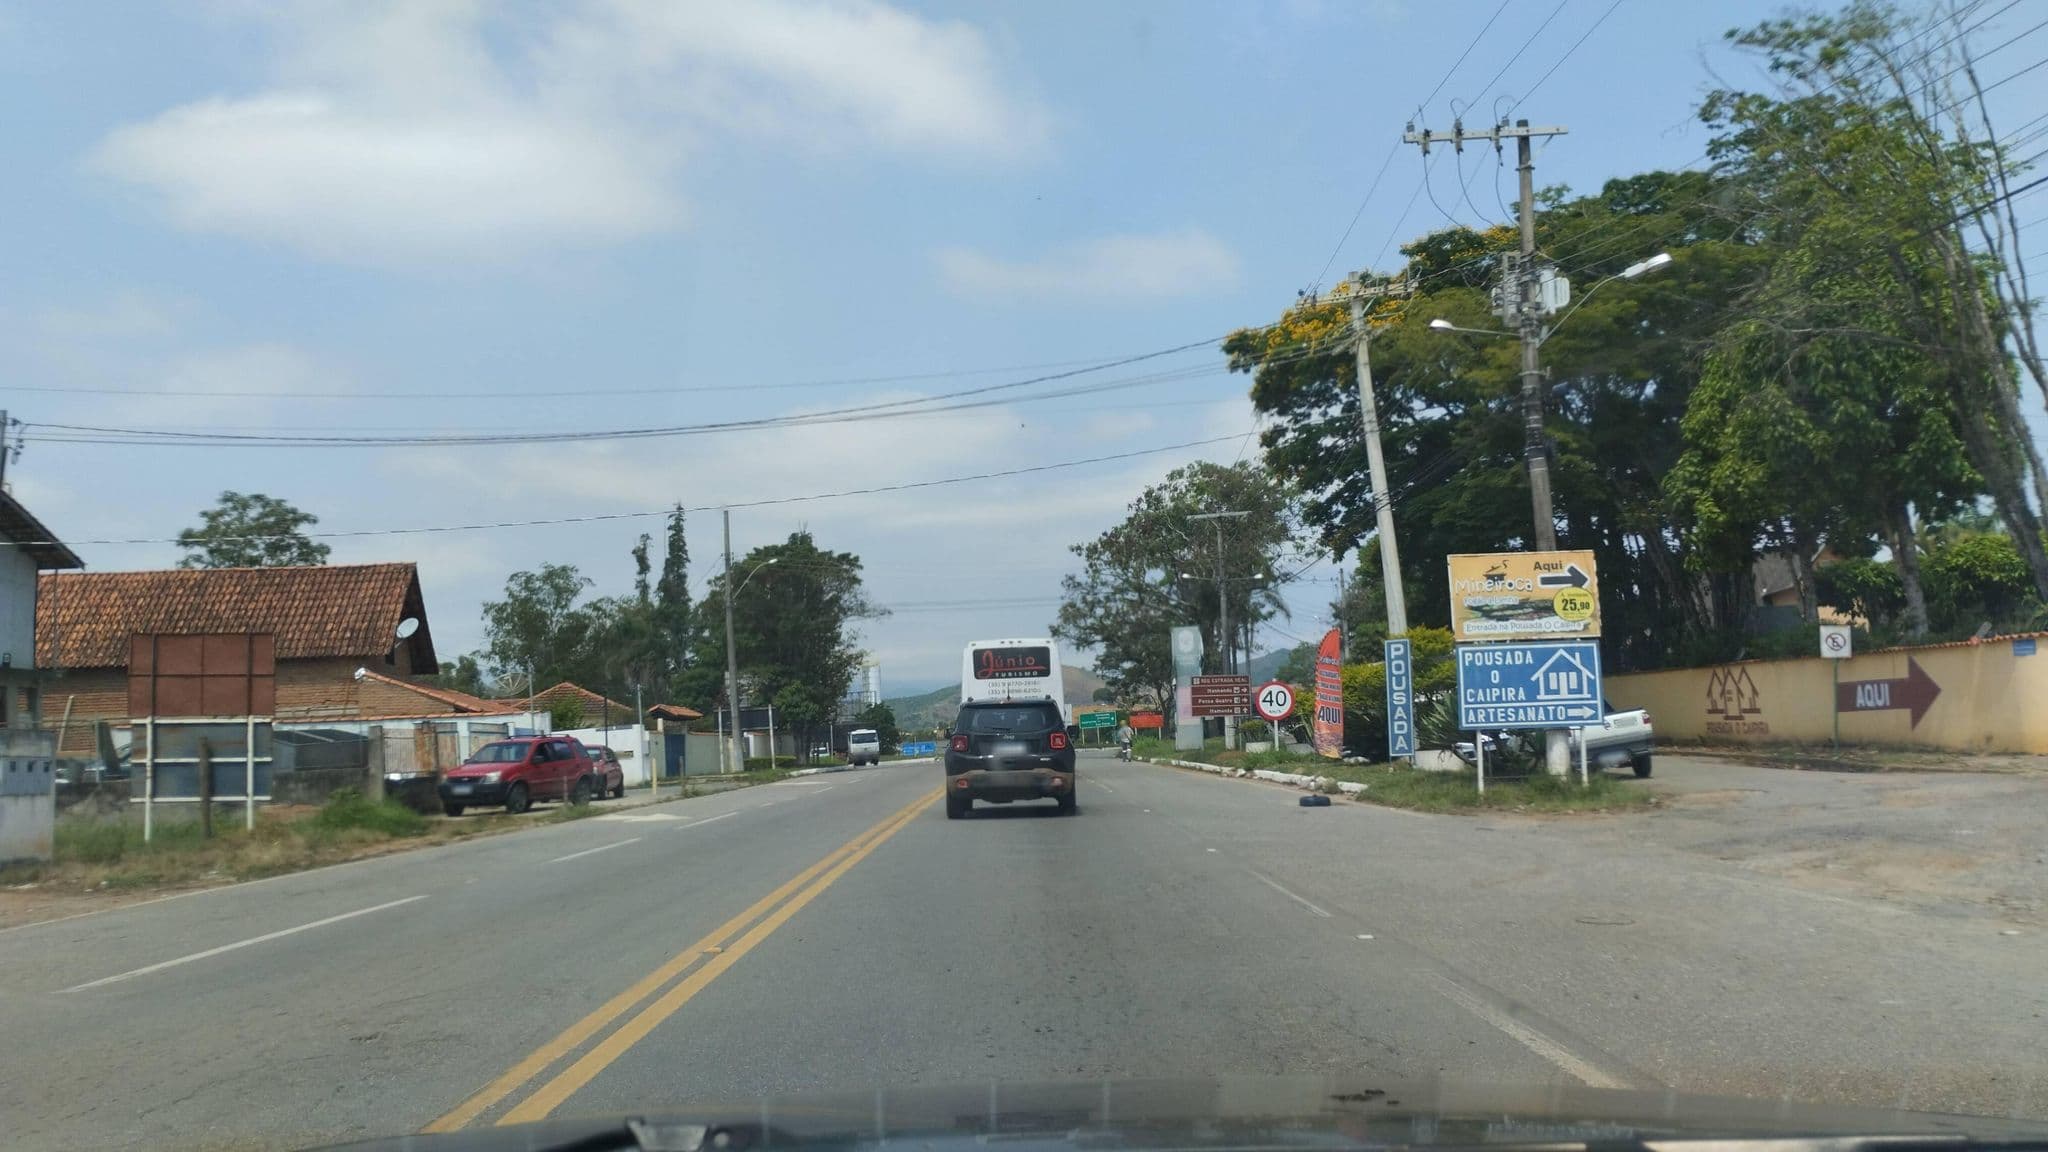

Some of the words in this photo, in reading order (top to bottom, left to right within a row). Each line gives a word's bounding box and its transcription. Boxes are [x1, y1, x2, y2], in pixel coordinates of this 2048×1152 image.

[1533, 561, 1563, 571] Aqui
[1562, 598, 1590, 611] 25,90
[1466, 622, 1498, 632] Entrada
[1500, 623, 1509, 632] na
[1510, 621, 1542, 632] Pousada
[1465, 650, 1533, 666] POUSADA
[1491, 670, 1500, 684] O
[1262, 690, 1286, 706] 40
[1390, 643, 1409, 751] POUSADA
[1466, 687, 1526, 702] CAIPIRA
[1856, 684, 1890, 708] AQUI
[1318, 706, 1341, 724] AQUI
[1468, 706, 1566, 723] ARTESANATO
